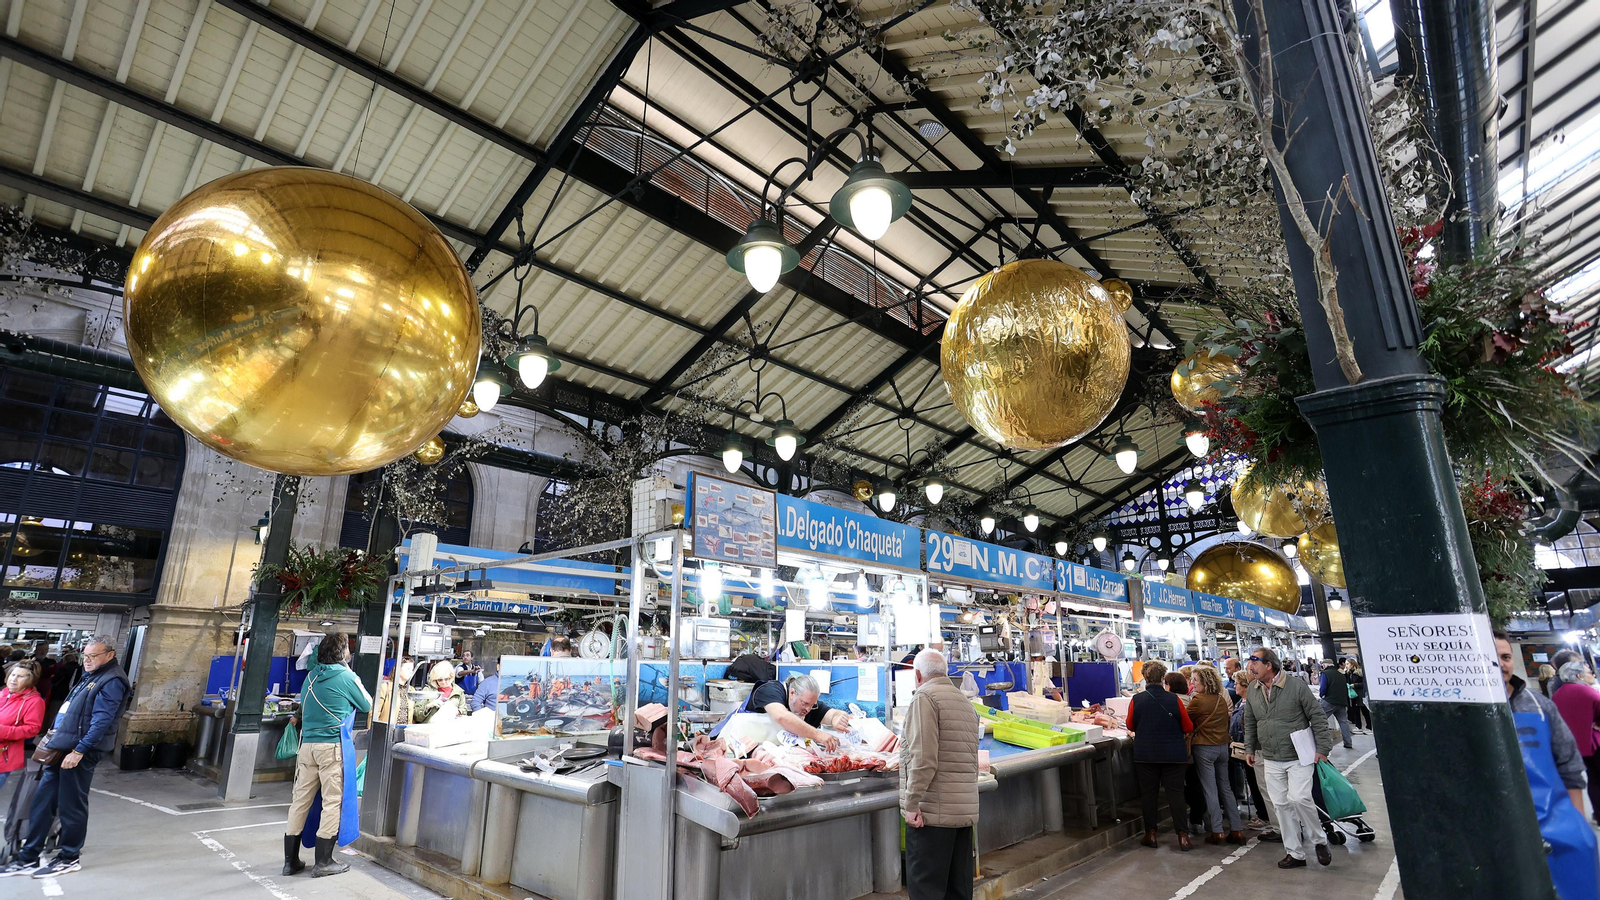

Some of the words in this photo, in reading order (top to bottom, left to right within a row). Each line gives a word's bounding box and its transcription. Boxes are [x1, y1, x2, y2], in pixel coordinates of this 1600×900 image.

[928, 529, 954, 571] 29
[1057, 561, 1073, 592] 31
[1085, 571, 1101, 592] Luis
[502, 602, 531, 614] Mauel
[1387, 623, 1473, 638] SEÑORES!
[1396, 641, 1420, 651] HAY
[1423, 639, 1473, 651] SEQUÍA
[1379, 653, 1403, 663] POR
[1405, 653, 1445, 663] FVOR
[1449, 653, 1490, 662] HAGAN
[1381, 665, 1406, 674] USO
[1408, 665, 1494, 675] RESPONSABLE
[1377, 677, 1402, 686] DEL
[1403, 677, 1443, 688] AGUA,
[1445, 677, 1500, 687] GRACIAS!
[1392, 687, 1406, 697] NO
